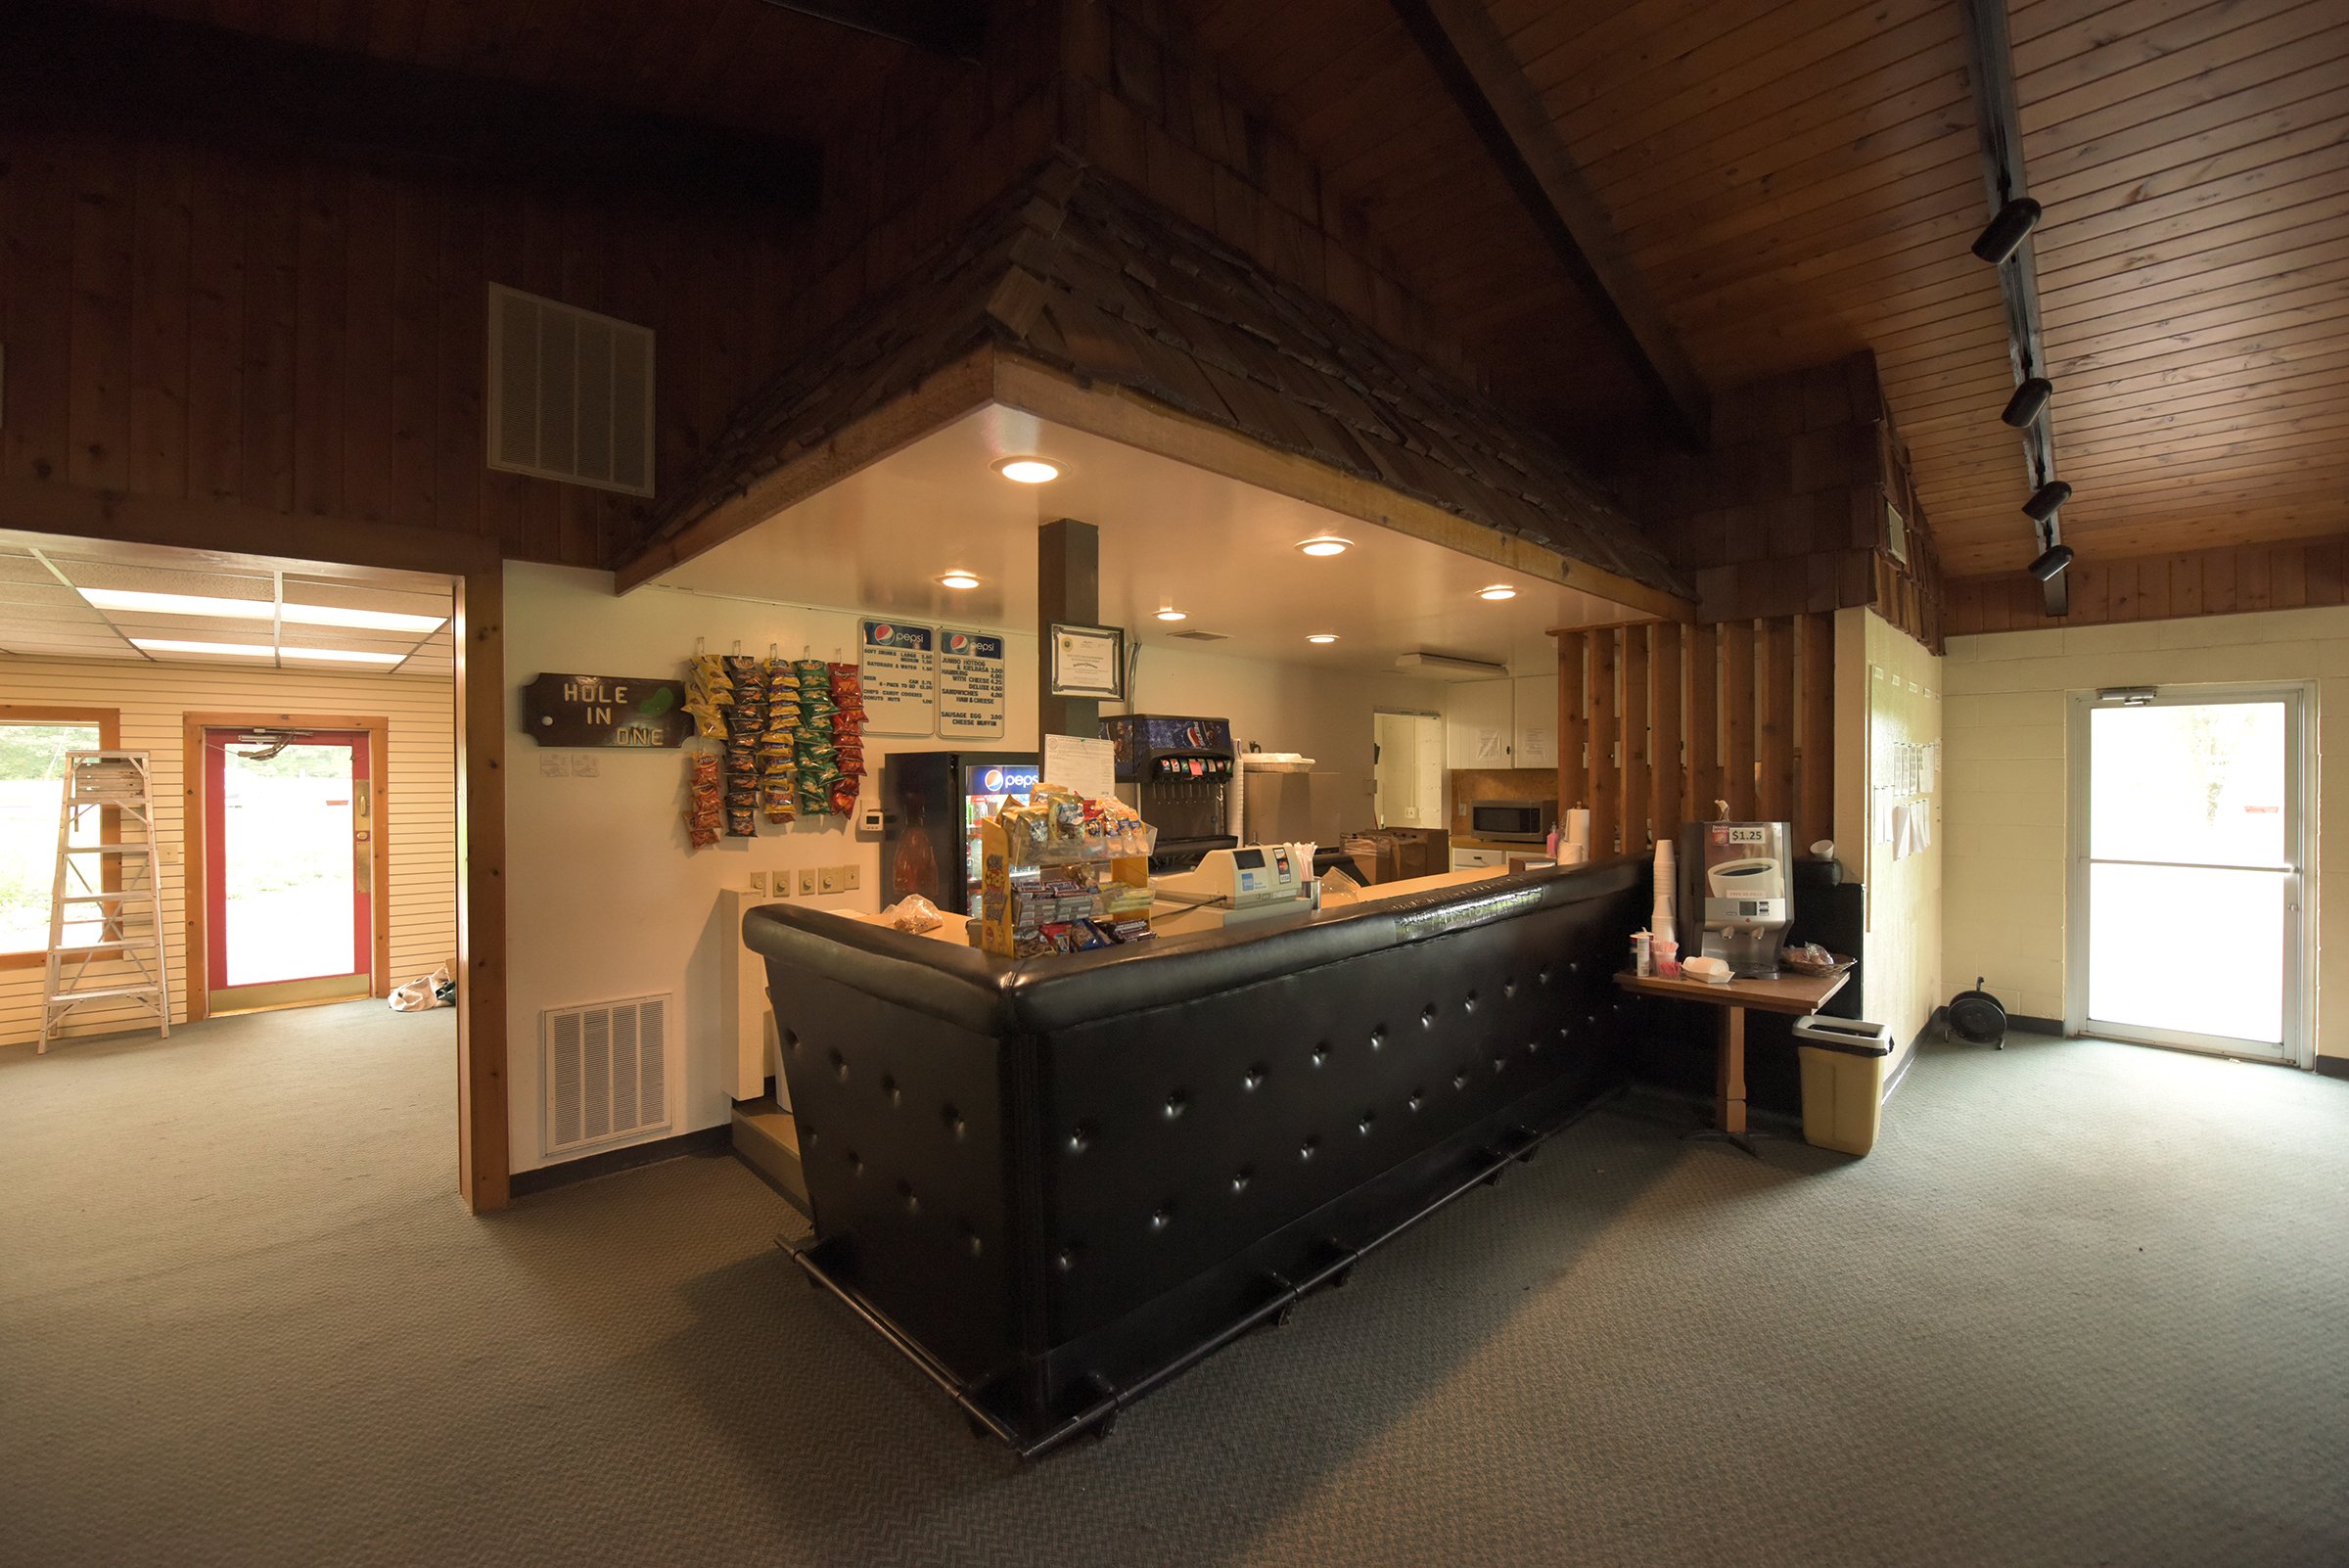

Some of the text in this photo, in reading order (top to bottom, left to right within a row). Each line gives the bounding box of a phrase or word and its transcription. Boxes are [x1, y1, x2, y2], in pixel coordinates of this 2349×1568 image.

[896, 633, 923, 643] pepsi
[564, 683, 628, 704] HOLE
[587, 707, 611, 725] IN
[617, 728, 663, 745] ONE
[1005, 775, 1039, 788] peps
[1732, 830, 1762, 841] $1.25
